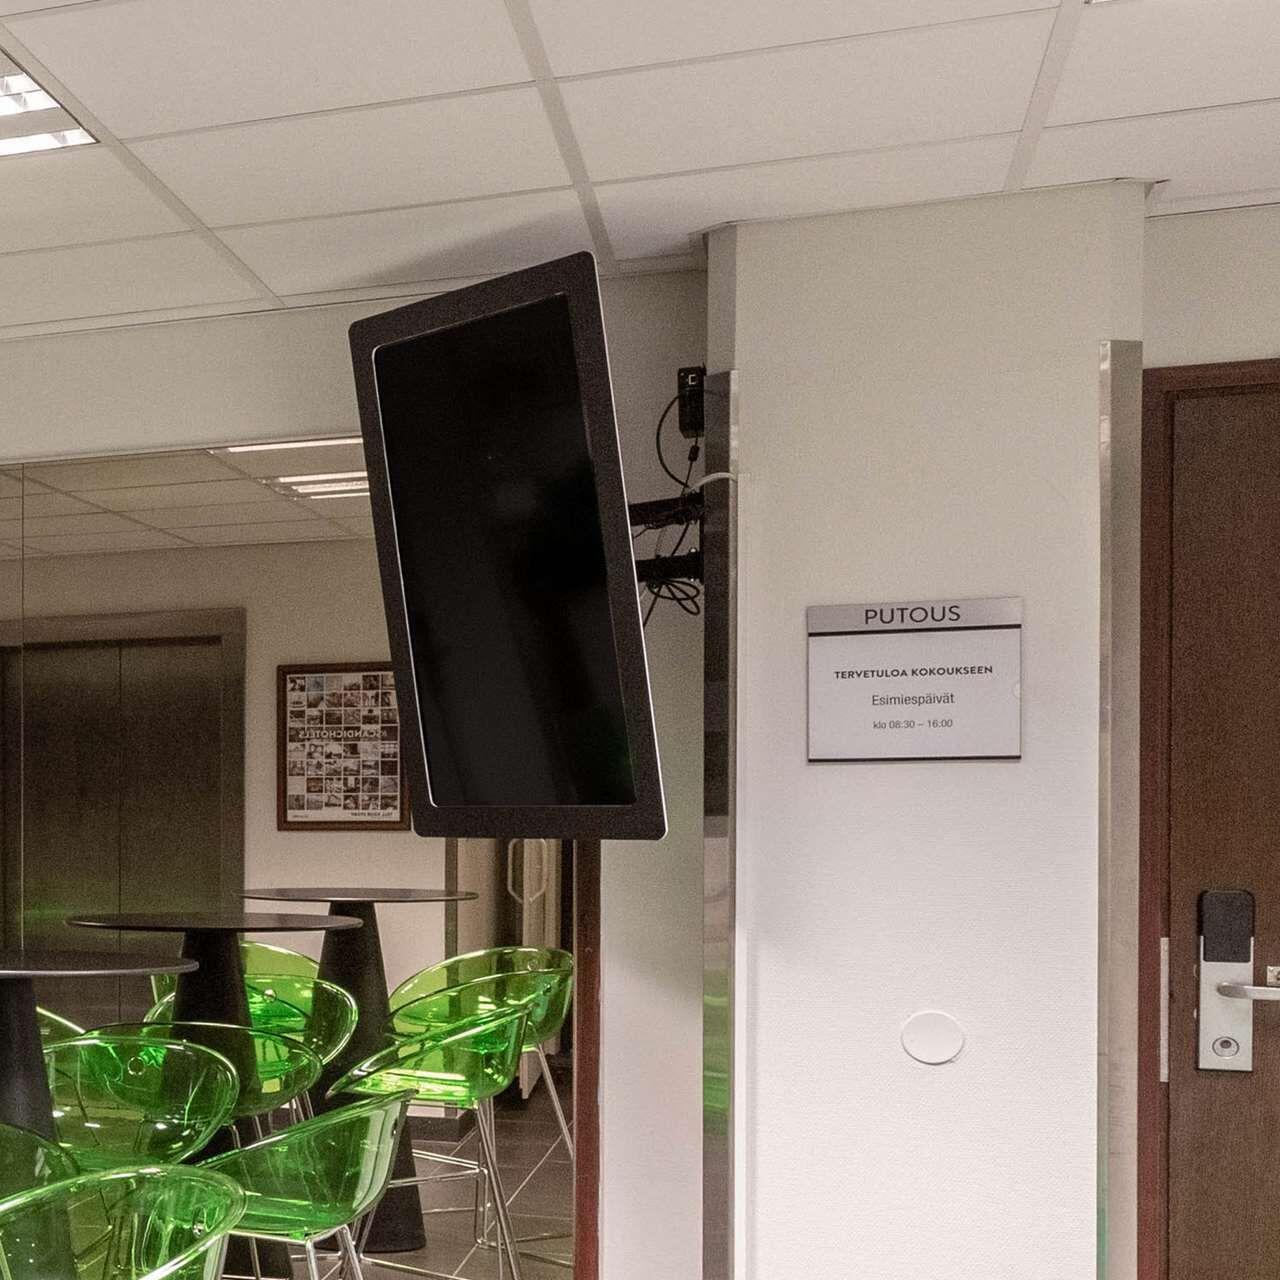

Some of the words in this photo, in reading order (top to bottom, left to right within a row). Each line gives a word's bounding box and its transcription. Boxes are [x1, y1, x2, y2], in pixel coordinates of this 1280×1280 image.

[864, 605, 961, 625] PUTOUS
[834, 668, 908, 680] TERVETULOA
[911, 665, 993, 678] KOKOUKSEEN
[871, 692, 955, 708] Esimiespäivät
[888, 719, 916, 730] 08:30
[927, 718, 953, 729] 16:00
